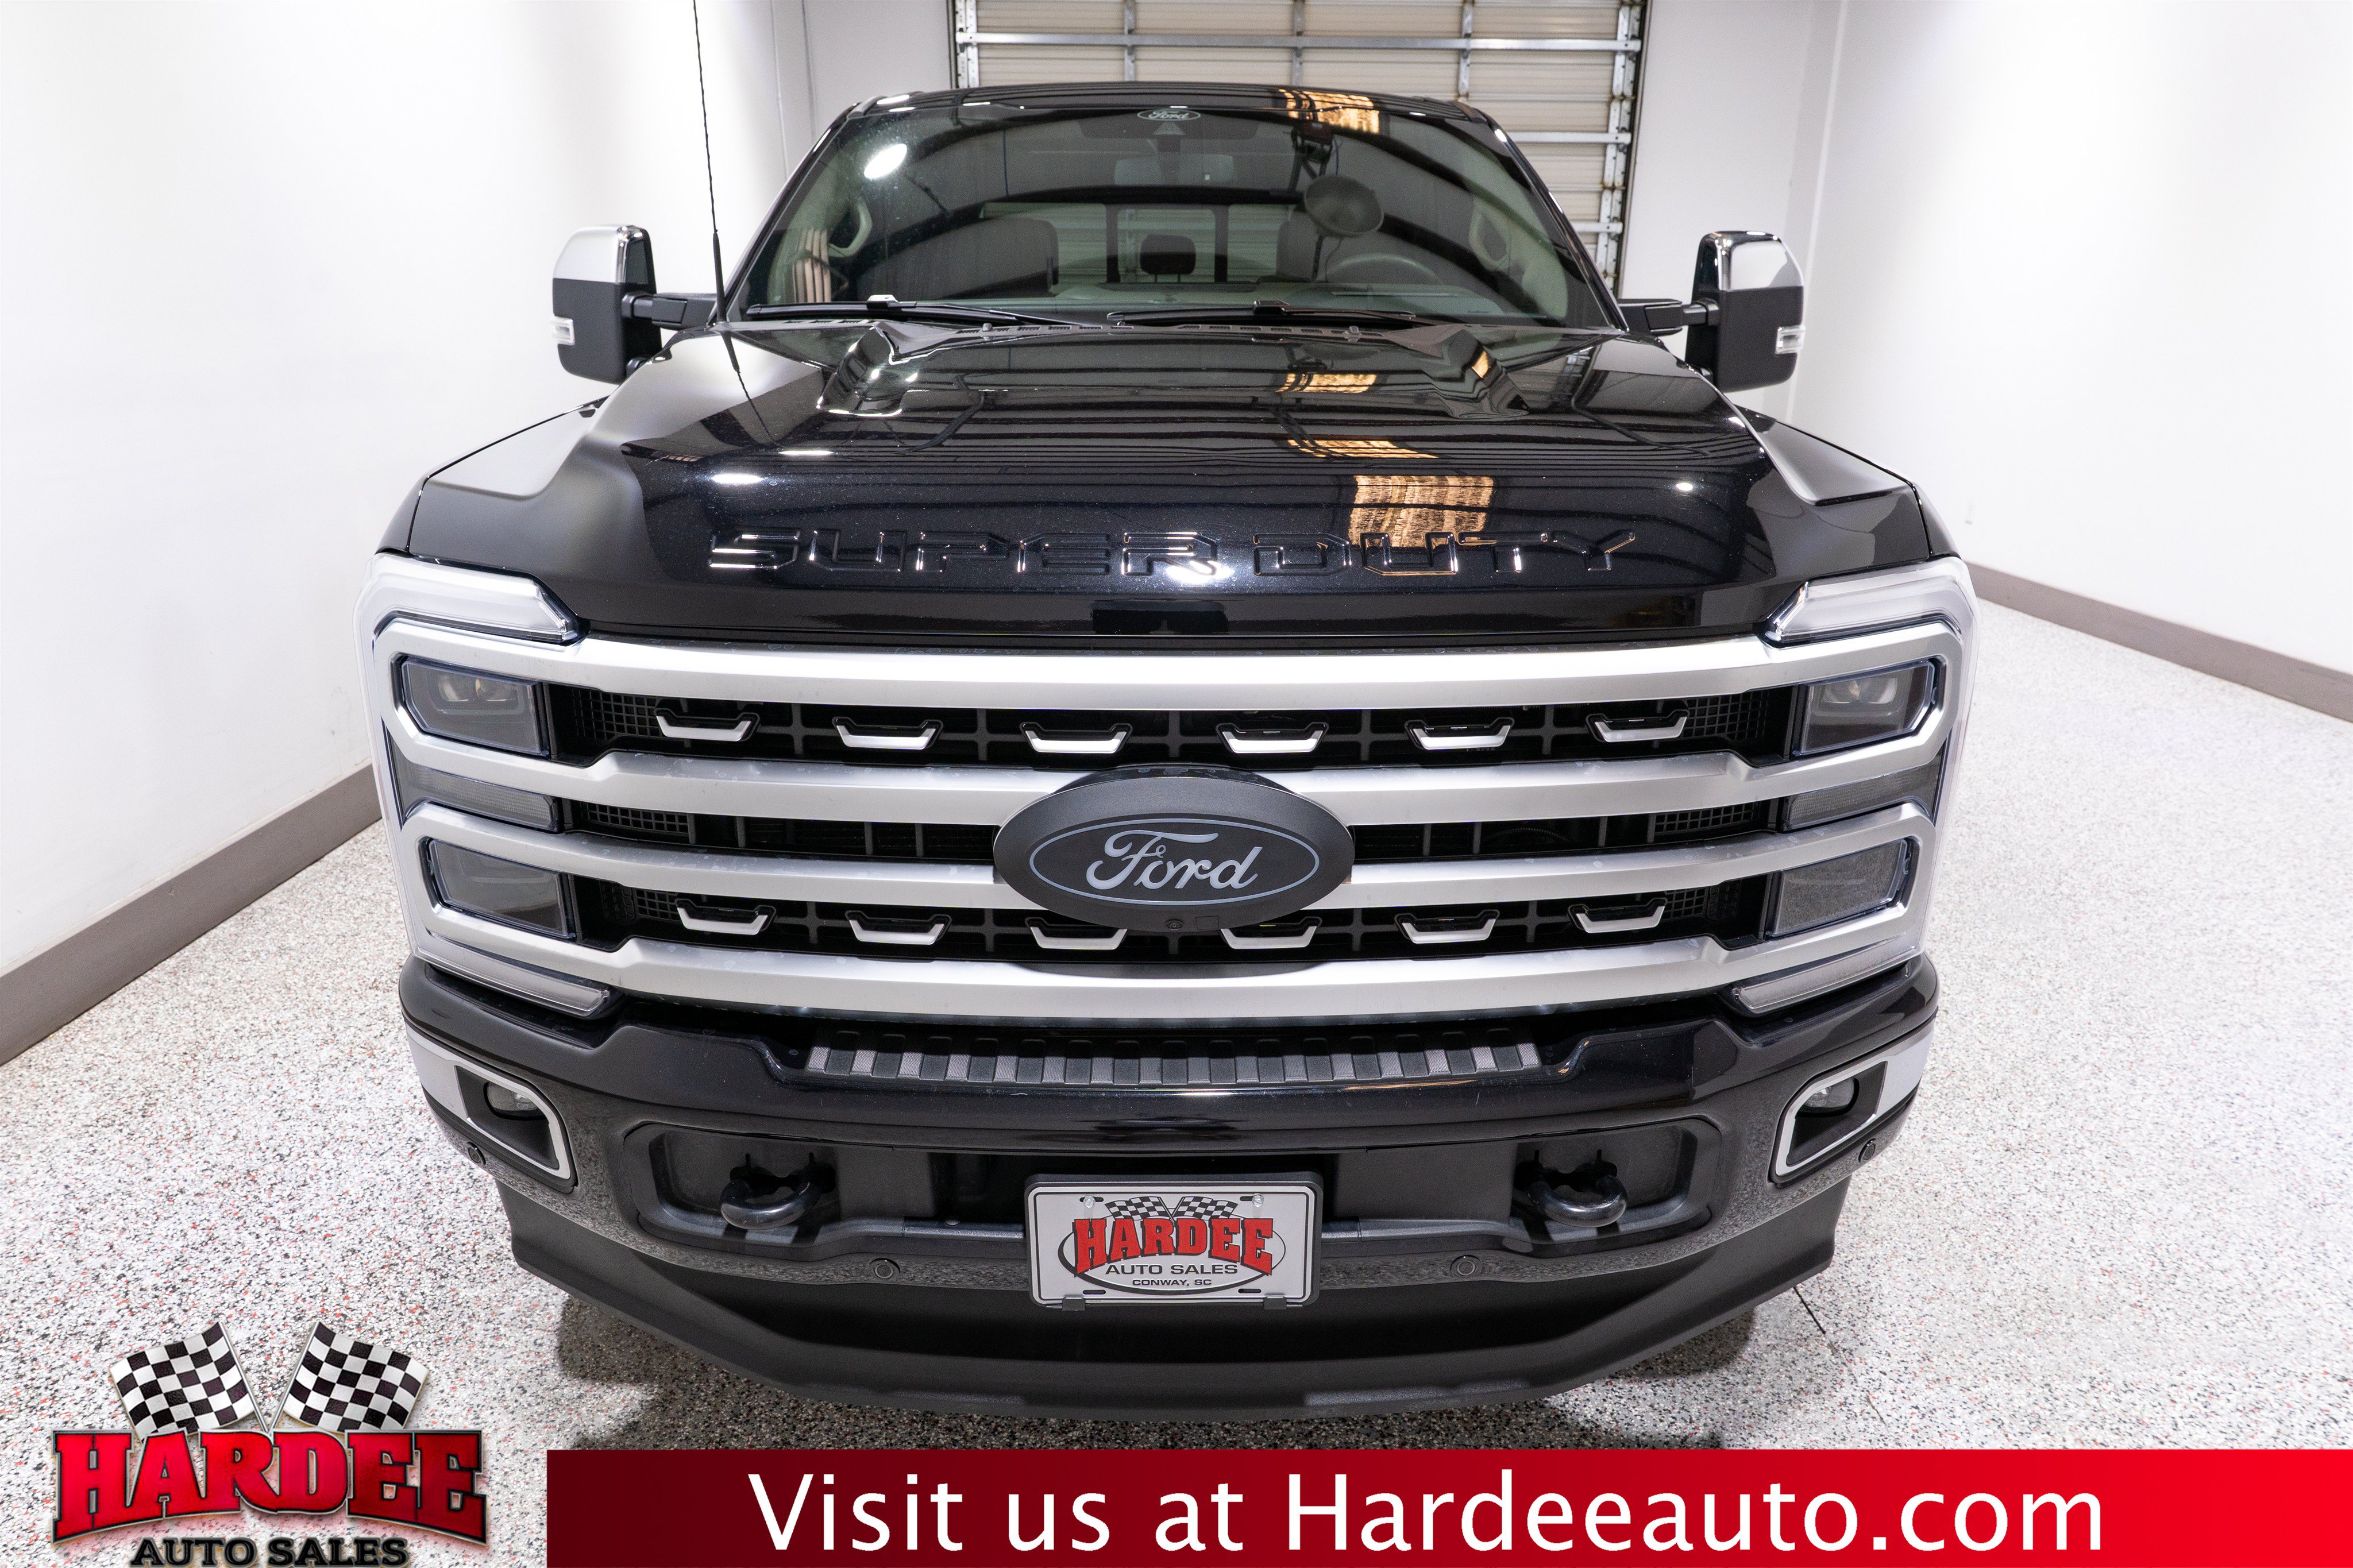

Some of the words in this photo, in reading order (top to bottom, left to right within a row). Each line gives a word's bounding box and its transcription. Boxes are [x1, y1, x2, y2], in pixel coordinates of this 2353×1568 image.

[1149, 110, 1189, 119] Ford
[709, 528, 1219, 576] SUPER
[1253, 530, 1636, 576] DUTY
[1086, 829, 1263, 890] Ford
[1073, 1218, 1274, 1277] HARDEE
[1105, 1264, 1163, 1276] AUTO
[1170, 1264, 1238, 1275] SALES
[1132, 1279, 1190, 1287] CONWAY,
